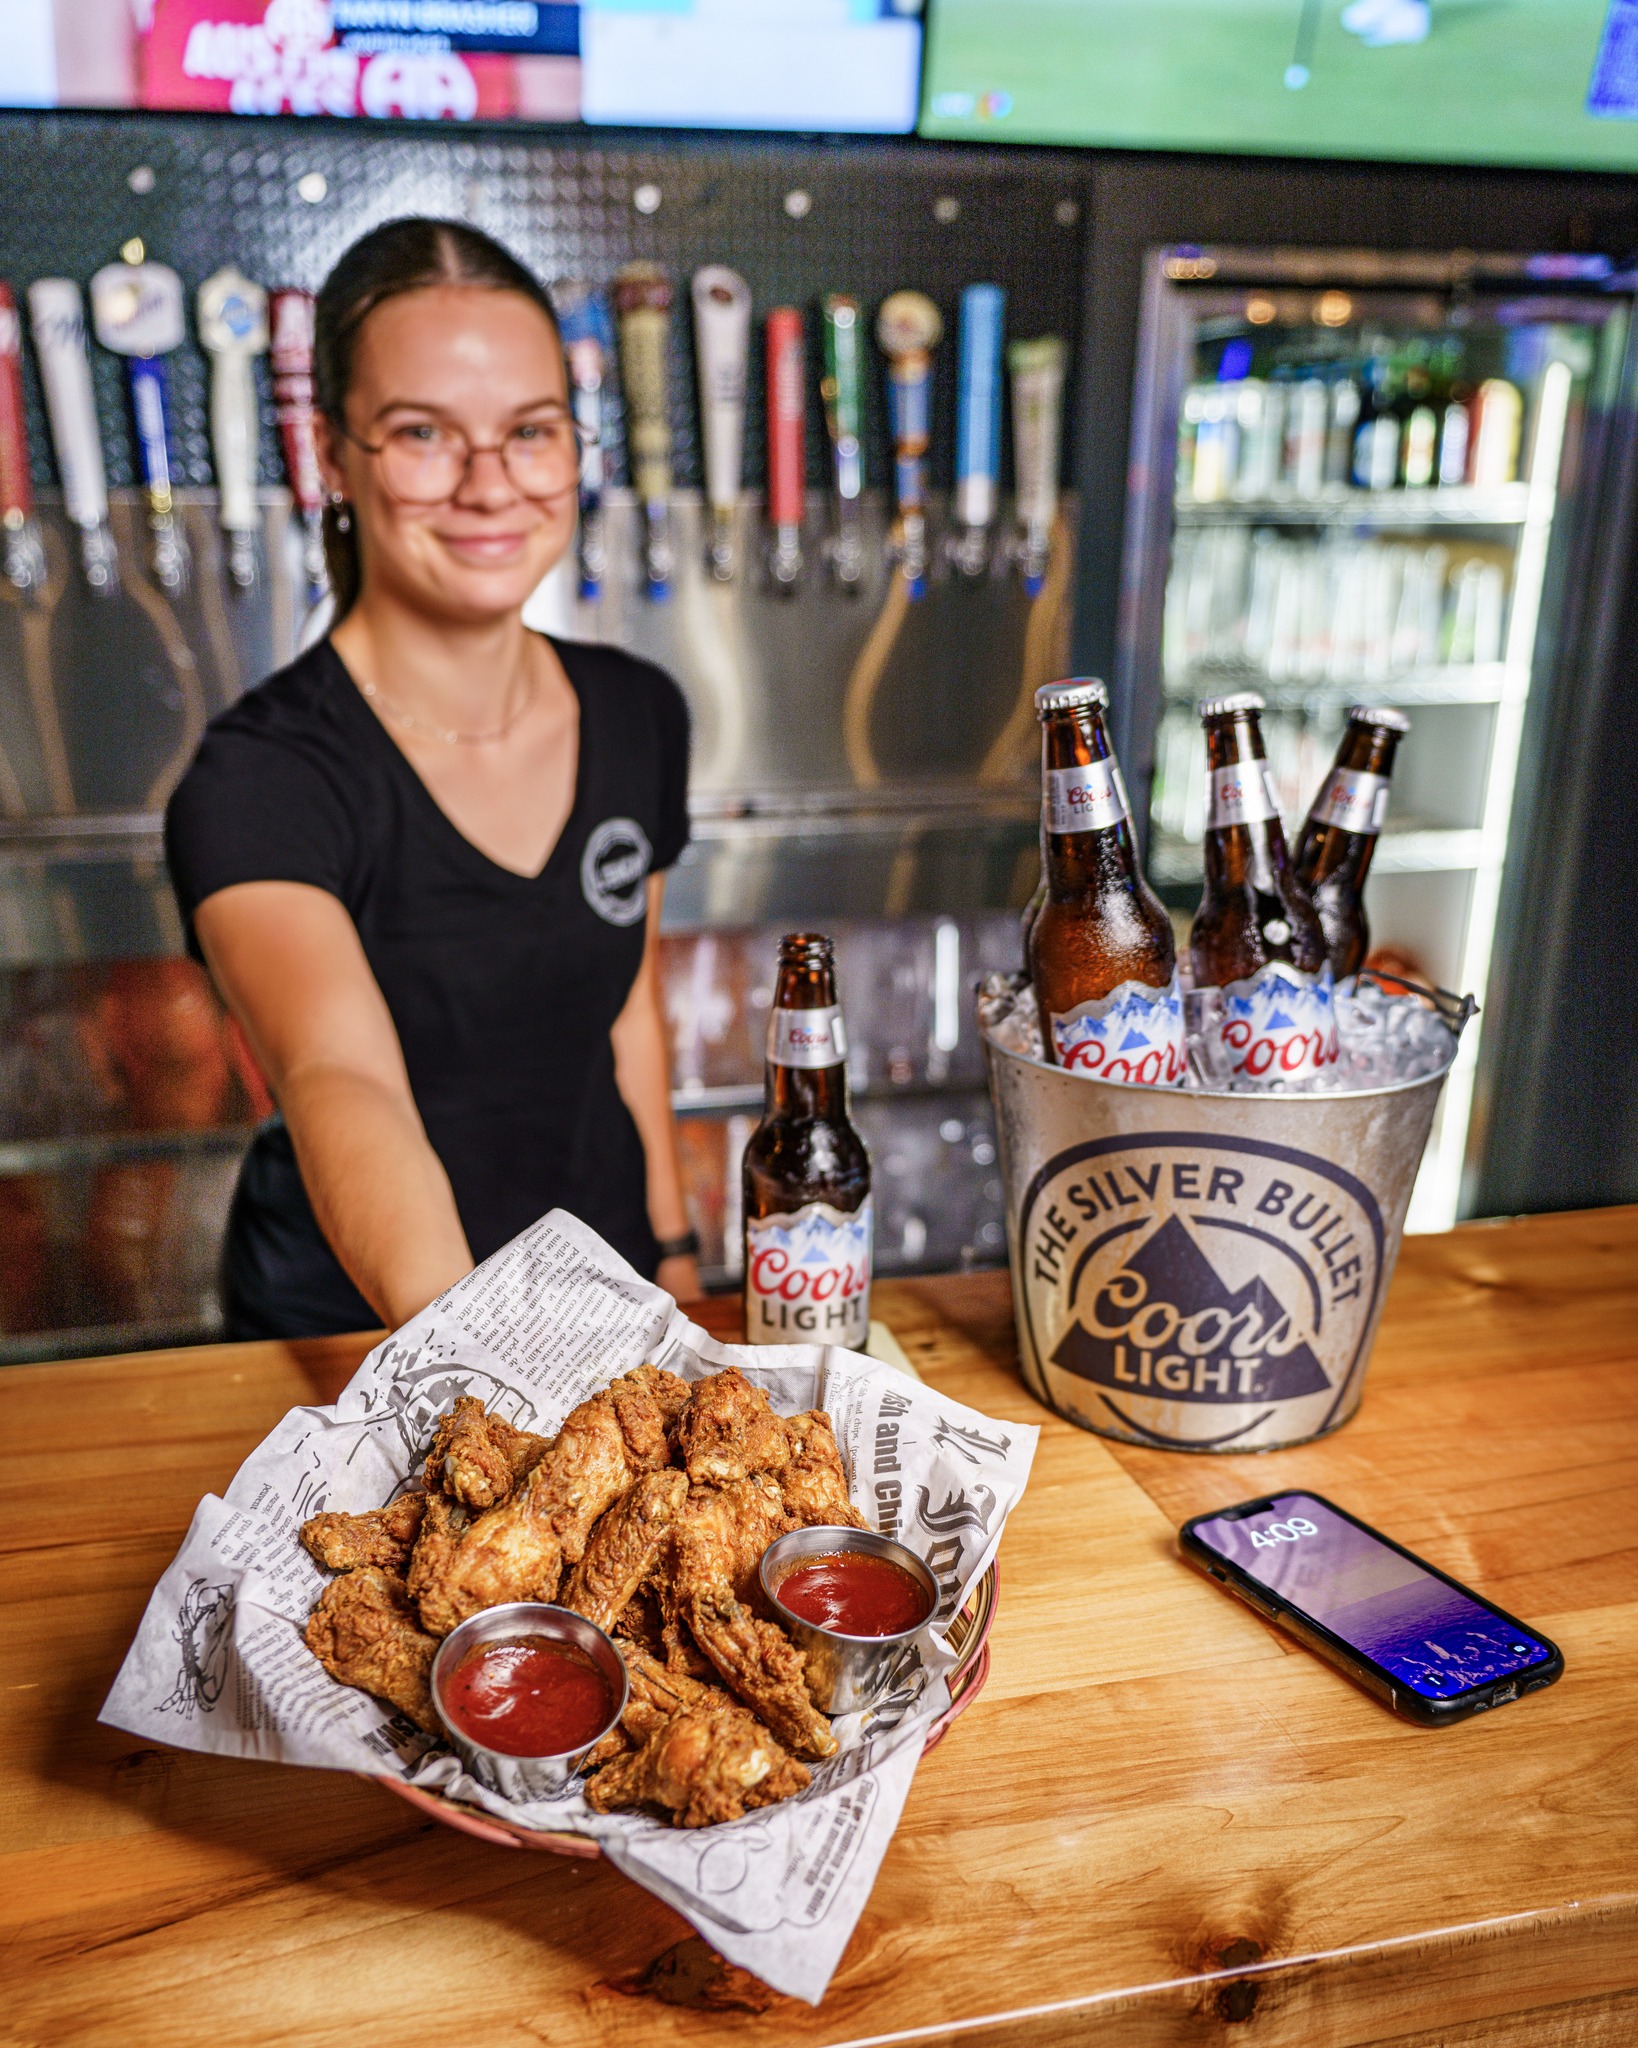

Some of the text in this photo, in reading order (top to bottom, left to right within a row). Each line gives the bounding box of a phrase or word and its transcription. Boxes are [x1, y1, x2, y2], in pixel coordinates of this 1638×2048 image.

[522, 1222, 545, 1243] remise
[1034, 1205, 1078, 1287] THE
[1066, 1163, 1244, 1222] SILVER
[545, 1234, 561, 1251] suite
[502, 1248, 520, 1266] l'eau
[463, 1228, 553, 1331] trouve dans un état tel que sa
[485, 1266, 503, 1287] serait
[518, 1257, 542, 1284] l'action
[749, 1244, 869, 1302] Coors
[509, 1285, 519, 1296] de
[578, 1269, 603, 1297] pratique
[472, 1286, 487, 1303] sans
[481, 1241, 570, 1347] nelle quand celui-ci est mort
[491, 1247, 579, 1353] pour la consommation person-
[440, 1301, 453, 1313] des
[456, 1303, 473, 1320] effet.
[490, 1294, 510, 1319] pêche
[500, 1256, 587, 1362] conserver le poisson pêché
[567, 1287, 601, 1330] maintenant
[589, 1293, 607, 1317] remise
[606, 1299, 619, 1319] peut
[760, 1296, 861, 1331] LIGHT
[1078, 1270, 1306, 1357] Coors
[480, 1319, 490, 1330] ou
[508, 1264, 595, 1367] est cependant coutumier de
[552, 1299, 576, 1333] courante
[636, 1308, 652, 1331] douce
[472, 1330, 481, 1339] se
[566, 1330, 583, 1347] l'eau
[615, 1321, 631, 1339] pour
[523, 1335, 552, 1363] (no-kill).
[540, 1333, 566, 1362] devenue
[592, 1339, 615, 1367] objectif
[593, 1338, 604, 1350] qui
[619, 1338, 628, 1348] en
[552, 1350, 564, 1363] des
[576, 1351, 592, 1367] dans
[607, 1348, 620, 1365] mer
[525, 1366, 538, 1380] une
[532, 1364, 551, 1386] prises
[556, 1368, 566, 1378] un
[562, 1369, 578, 1385] bien
[585, 1364, 594, 1373] le
[597, 1365, 607, 1376] est
[545, 1379, 556, 1390] art.
[551, 1386, 562, 1399] des
[568, 1371, 585, 1396] plaisir
[586, 1376, 599, 1390] une
[560, 1396, 569, 1406] de
[855, 1400, 863, 1414] and
[851, 1418, 862, 1441] chips,
[874, 1423, 904, 1474] and
[849, 1445, 859, 1480] (poisson
[852, 1484, 858, 1494] et
[211, 1483, 272, 1547] peuvent intoxica-
[234, 1516, 253, 1540] quoi
[1249, 1517, 1319, 1550] 4:09
[231, 1541, 253, 1561] (non
[243, 1548, 260, 1566] con-
